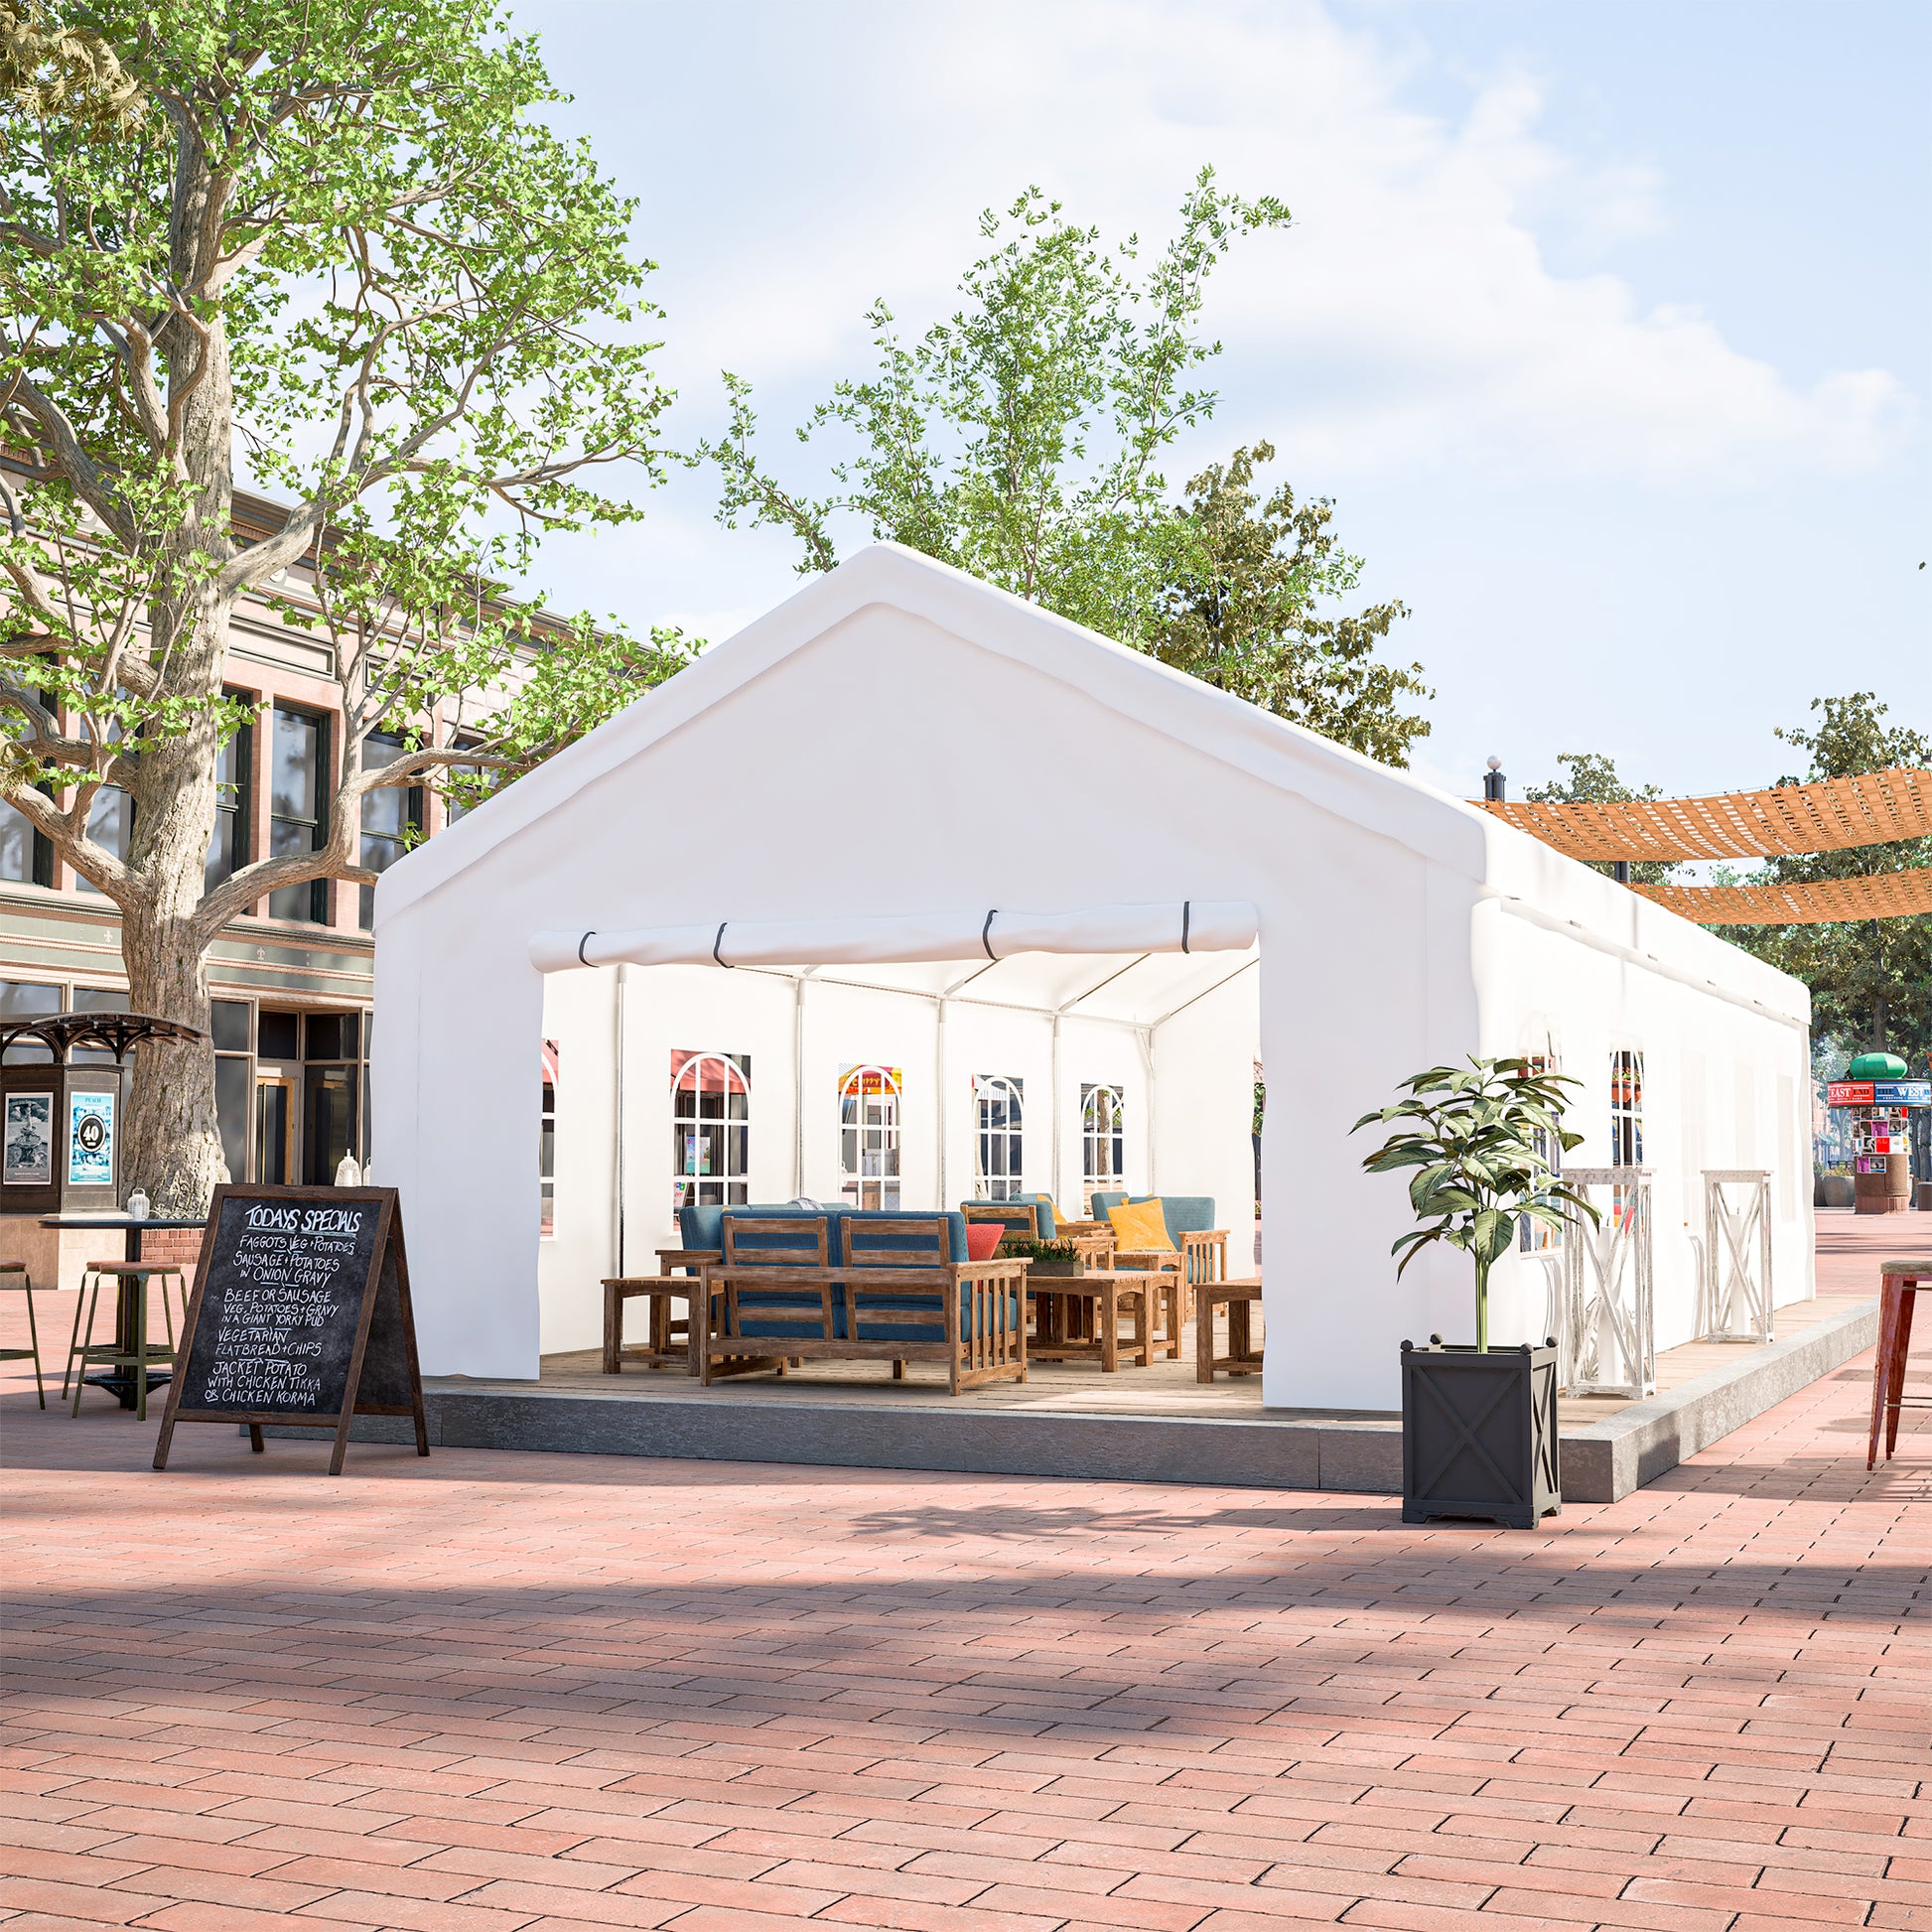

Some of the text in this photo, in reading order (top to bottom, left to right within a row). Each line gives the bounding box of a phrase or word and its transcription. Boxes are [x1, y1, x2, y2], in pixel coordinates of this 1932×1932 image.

[1831, 1088, 1852, 1097] EAST
[1896, 1087, 1924, 1097] WEST
[83, 1125, 99, 1141] 40
[245, 1204, 362, 1233] TODAYS SPECIALS
[239, 1234, 287, 1251] FAGGOTS
[289, 1234, 309, 1251] VEG
[239, 1266, 332, 1288] IN ONION GRAVY
[223, 1288, 332, 1304] BEEF OR SAUSAGE
[242, 1313, 271, 1324] GIANT
[275, 1314, 304, 1326] YORKY
[305, 1315, 325, 1326] PUD
[217, 1326, 290, 1343] VEGETARIAN
[212, 1360, 308, 1377] JACKET POTATO
[207, 1376, 321, 1391] WITH CHICKEN TIKKA
[205, 1388, 316, 1406] OR CHICKEN KORMA
